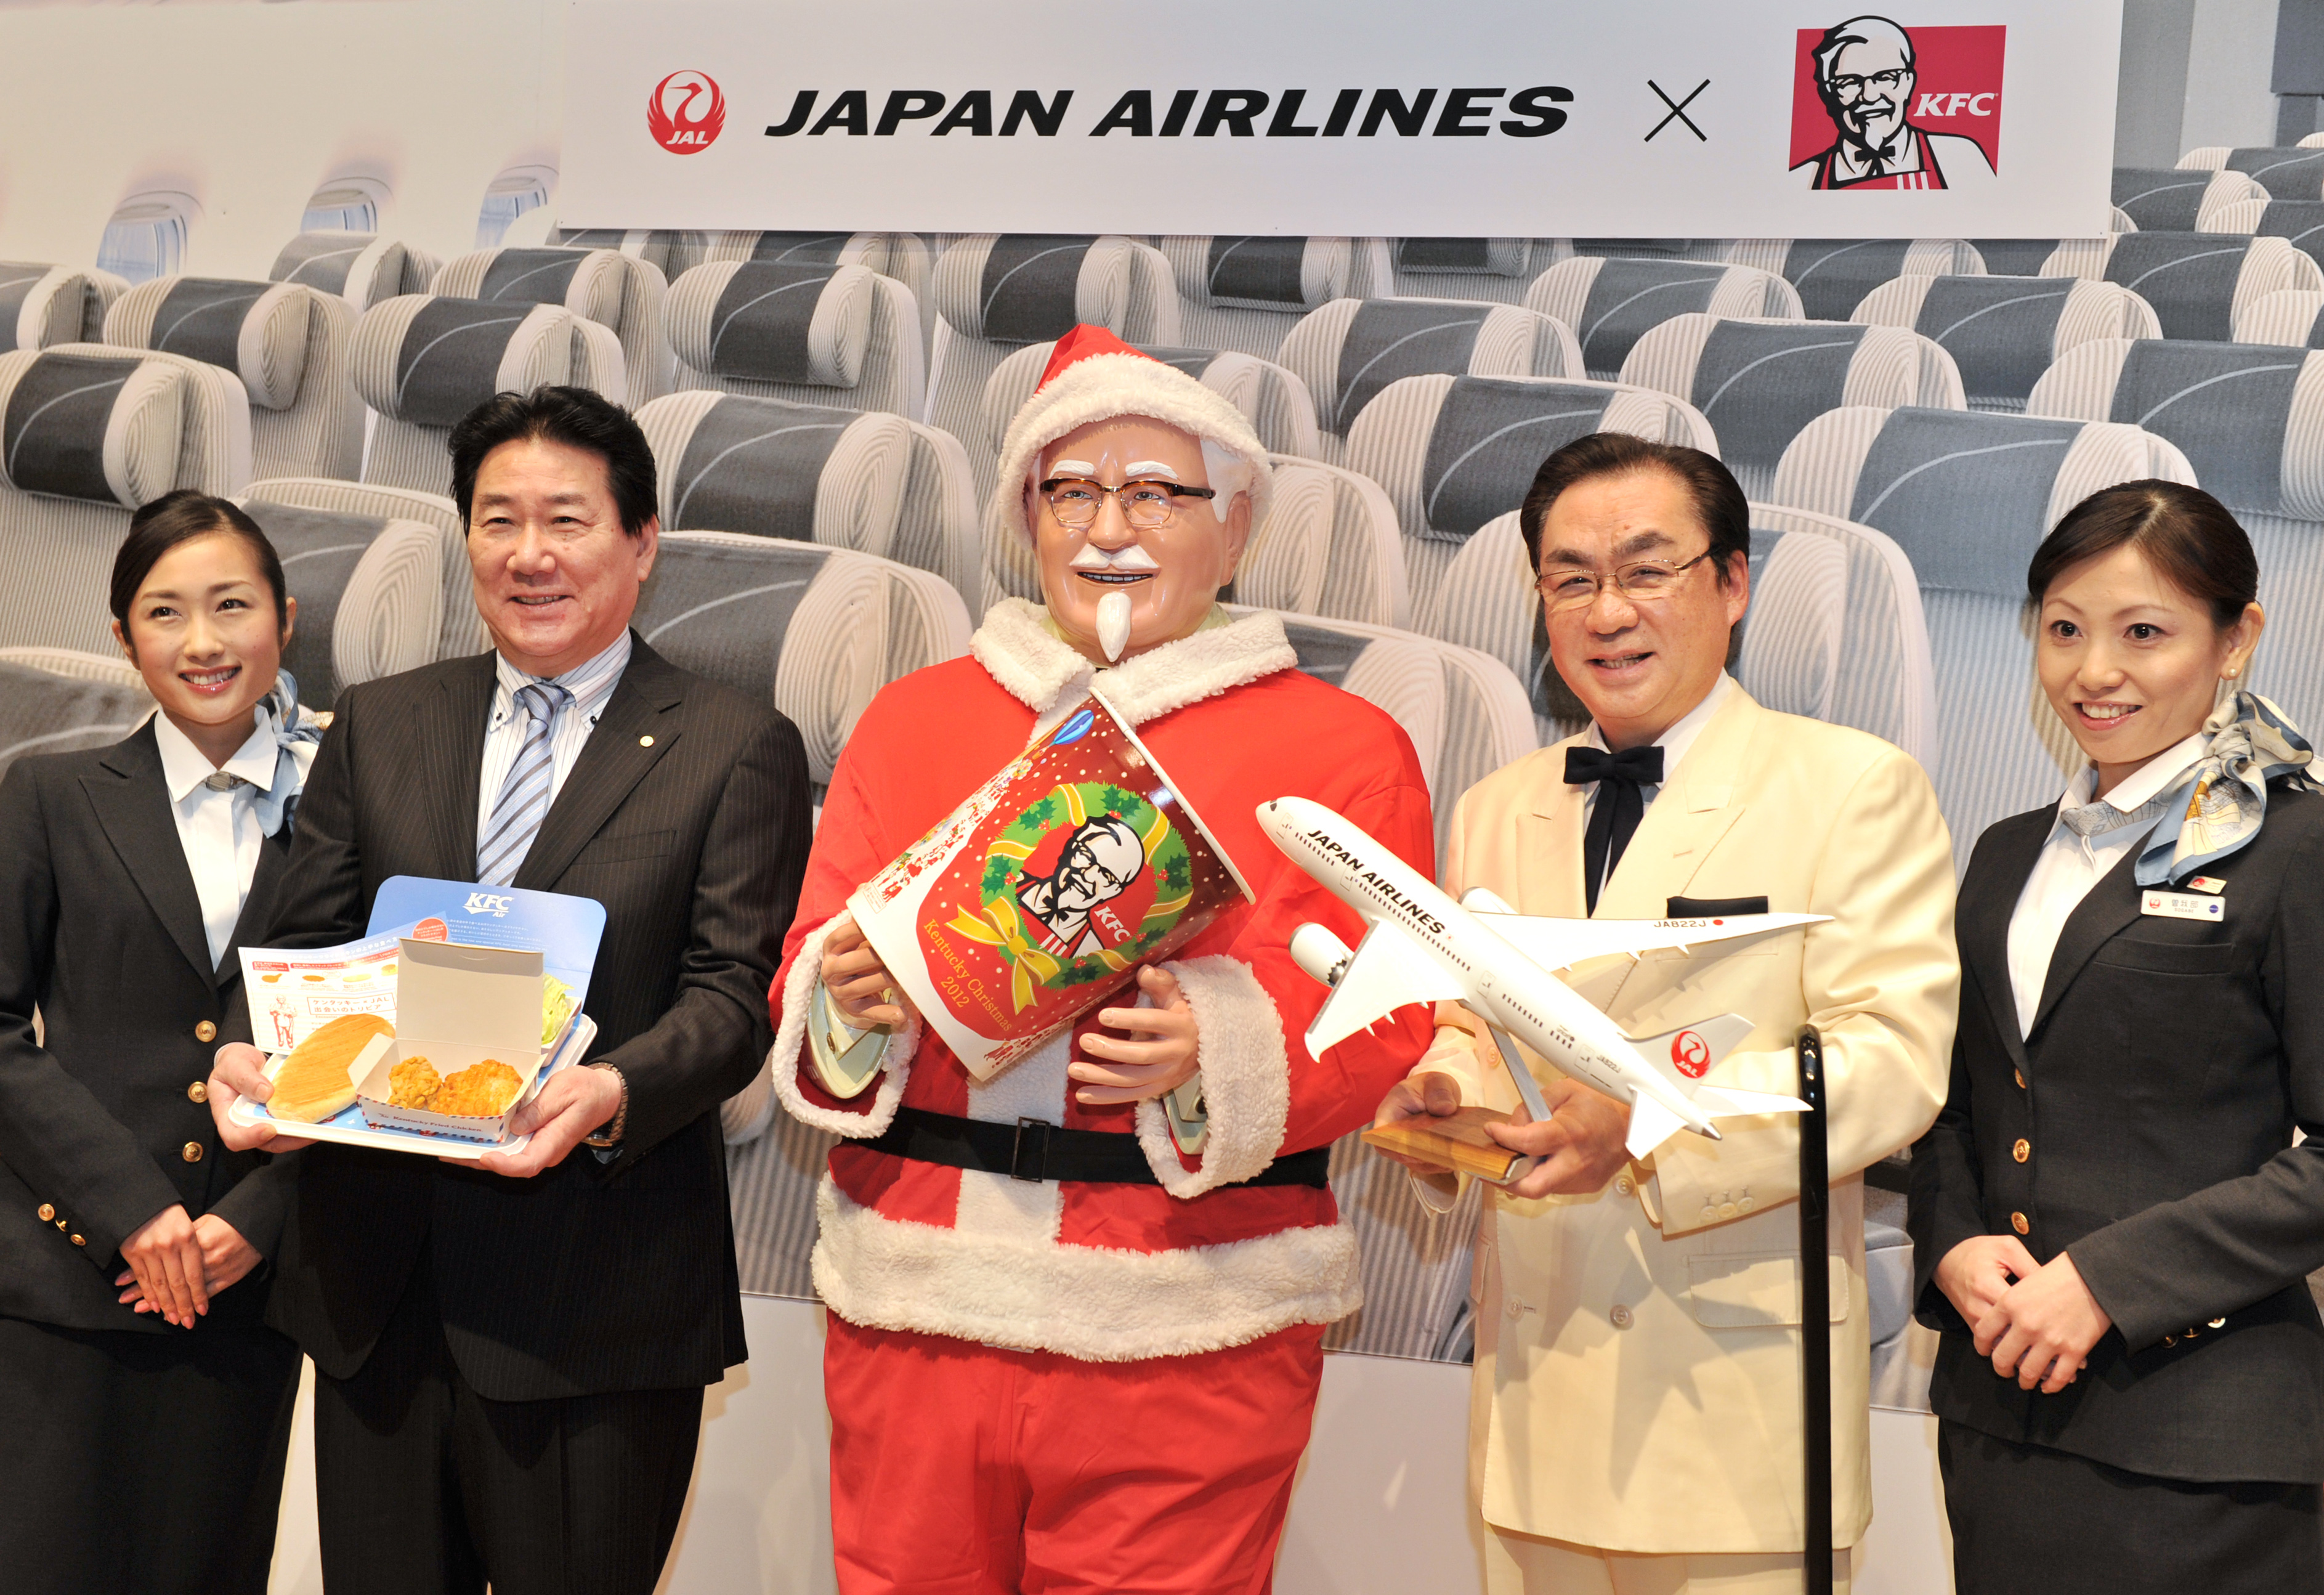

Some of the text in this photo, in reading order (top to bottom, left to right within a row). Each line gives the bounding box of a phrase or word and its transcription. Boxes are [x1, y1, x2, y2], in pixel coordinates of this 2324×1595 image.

[765, 91, 1074, 137] JAPAN
[1089, 86, 1574, 137] AIRLINES
[1914, 92, 1998, 117] KFC
[666, 131, 709, 145] JAL
[1308, 830, 1446, 935] JAPAN AIRLINES
[464, 892, 514, 911] KFC
[1095, 906, 1130, 942] KFC
[1654, 920, 1707, 928] JA822J
[923, 919, 1013, 1032] Kentucky Christmas
[941, 976, 970, 1008] 2012
[314, 1004, 381, 1013] 出会いのトリビア
[1676, 1060, 1698, 1078] JAL
[393, 1116, 429, 1126] Kentucky
